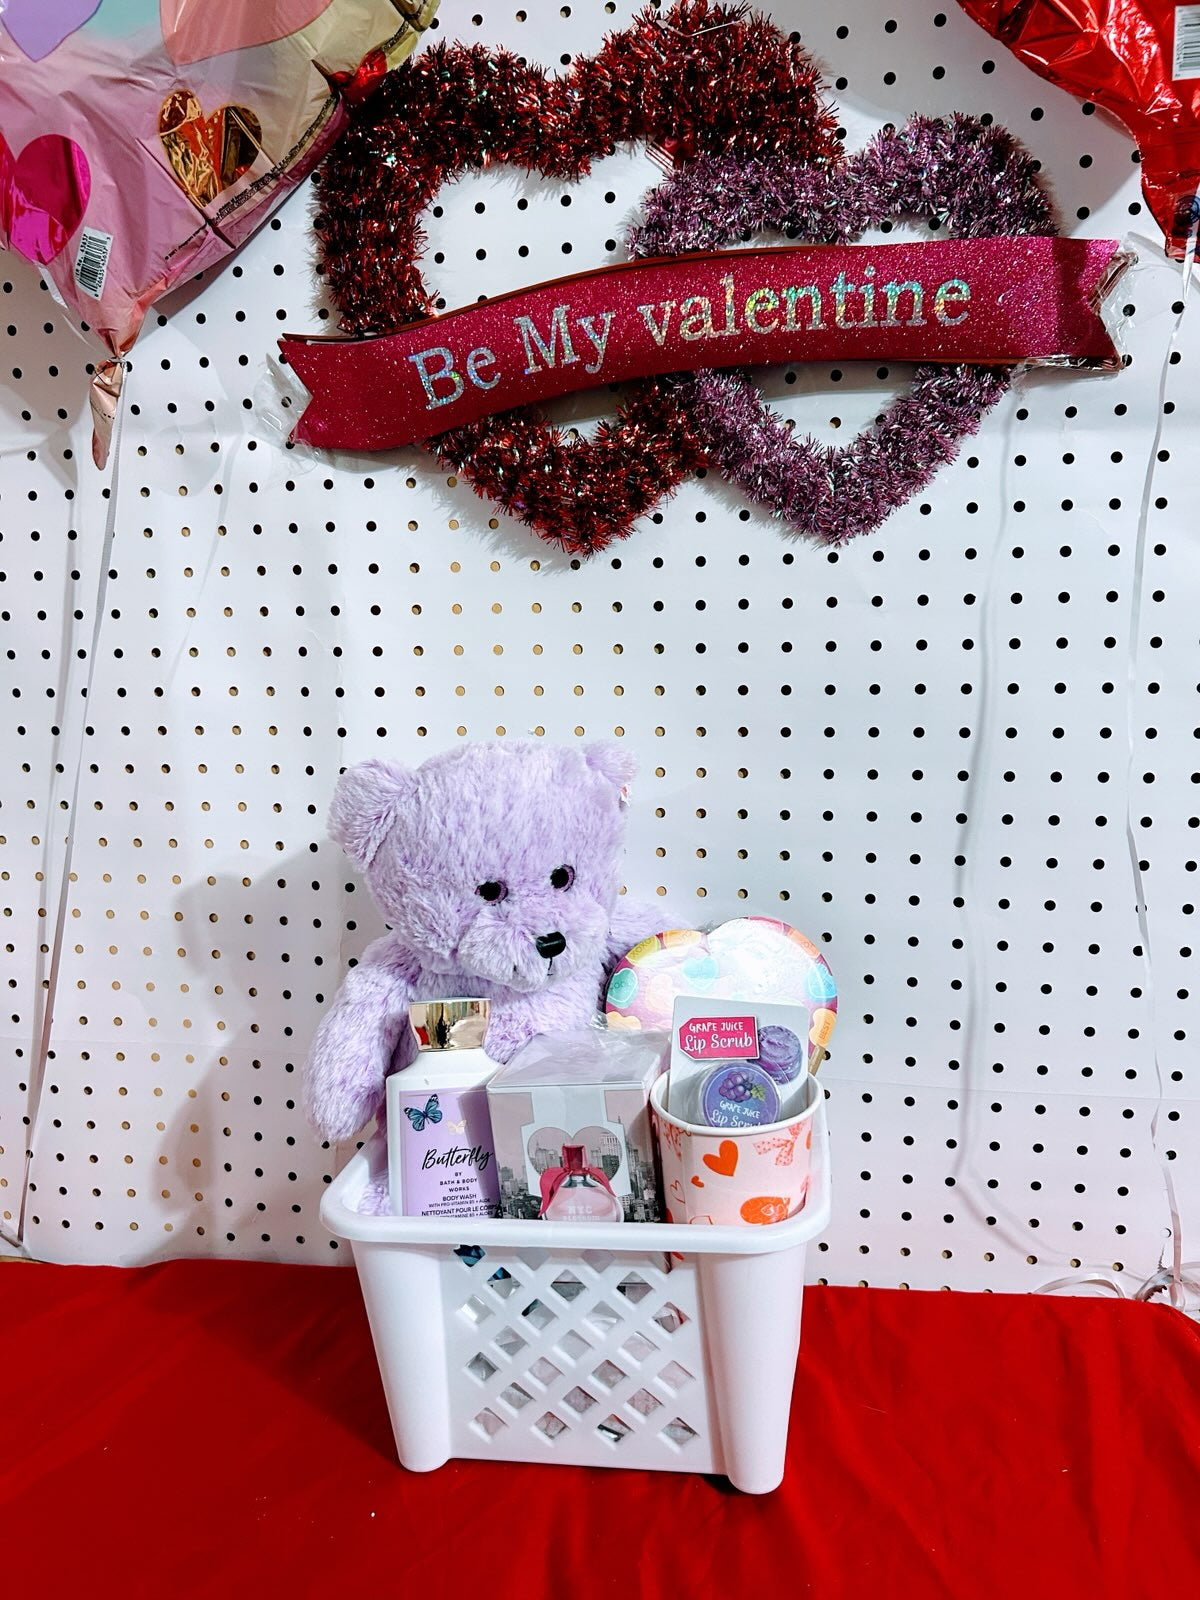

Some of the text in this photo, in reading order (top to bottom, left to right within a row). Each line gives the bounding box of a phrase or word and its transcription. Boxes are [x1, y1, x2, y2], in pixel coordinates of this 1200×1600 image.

[408, 264, 972, 410] Be My valentine
[689, 1021, 717, 1034] GRAPE
[684, 1031, 753, 1054] Lip Scrub
[719, 1100, 741, 1114] GRAPE
[711, 1109, 728, 1126] Lip
[421, 1145, 494, 1171] Butterfly
[421, 1209, 455, 1217] NETTOYANT
